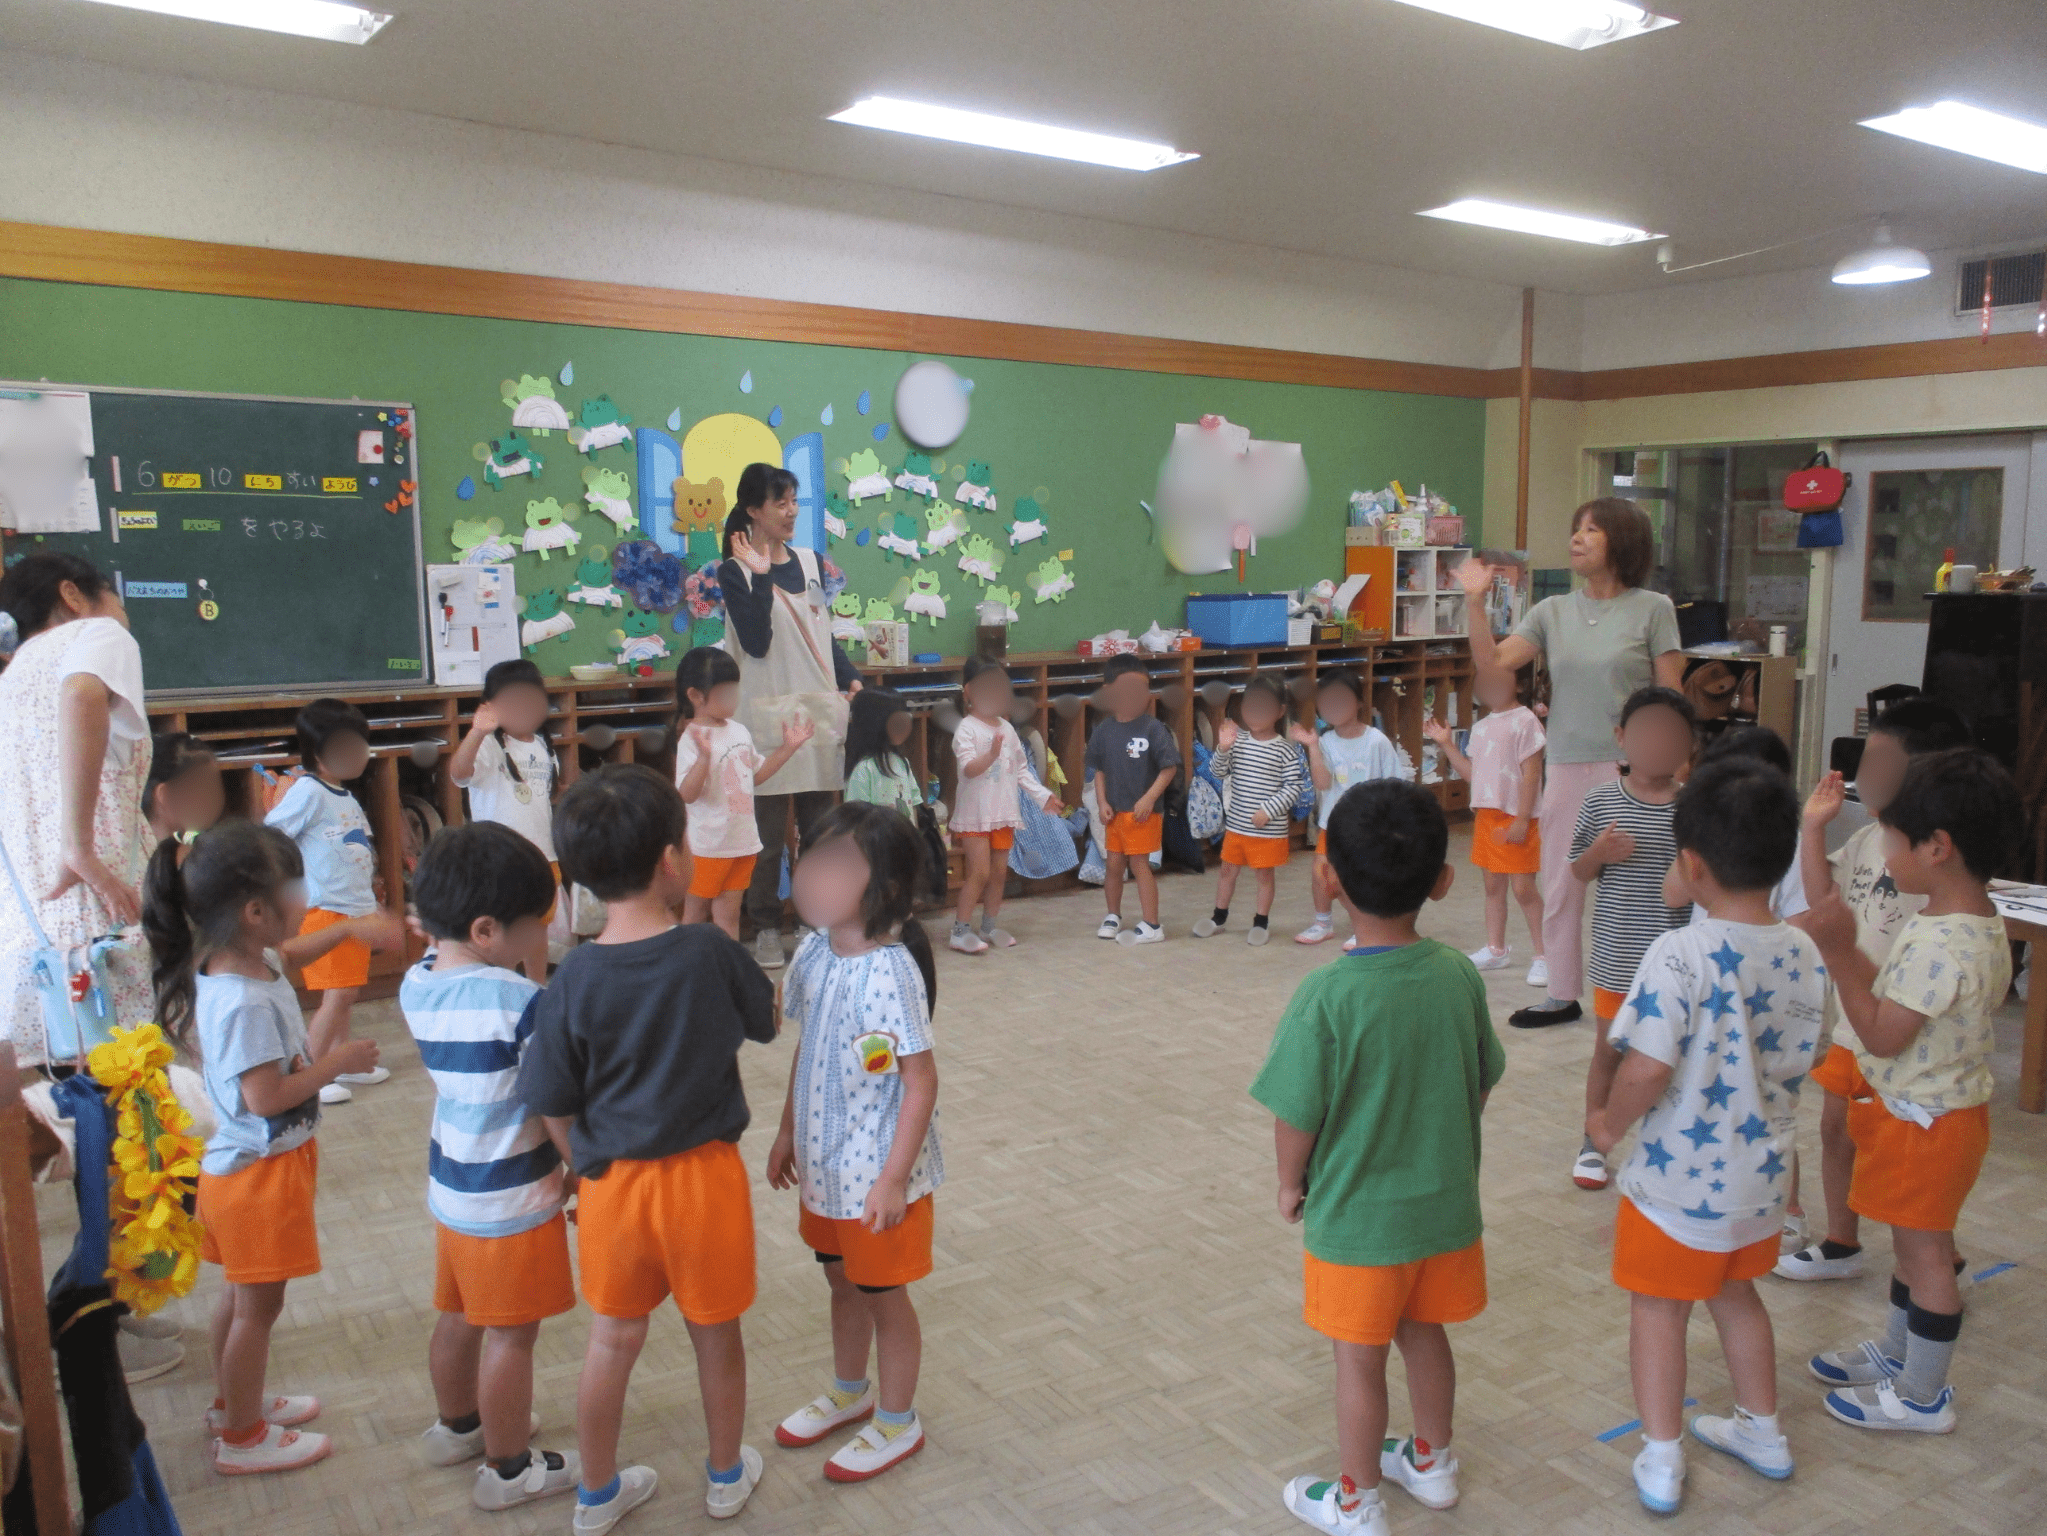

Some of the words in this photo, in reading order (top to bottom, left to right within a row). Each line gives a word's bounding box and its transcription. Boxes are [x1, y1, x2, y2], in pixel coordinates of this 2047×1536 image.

[137, 460, 155, 487] 6
[167, 474, 197, 487] がつ
[210, 467, 232, 488] 10
[250, 476, 275, 488] にち
[286, 469, 316, 490] すい
[325, 479, 357, 490] ようび
[240, 517, 327, 541] をやるよ
[204, 603, 215, 617] B
